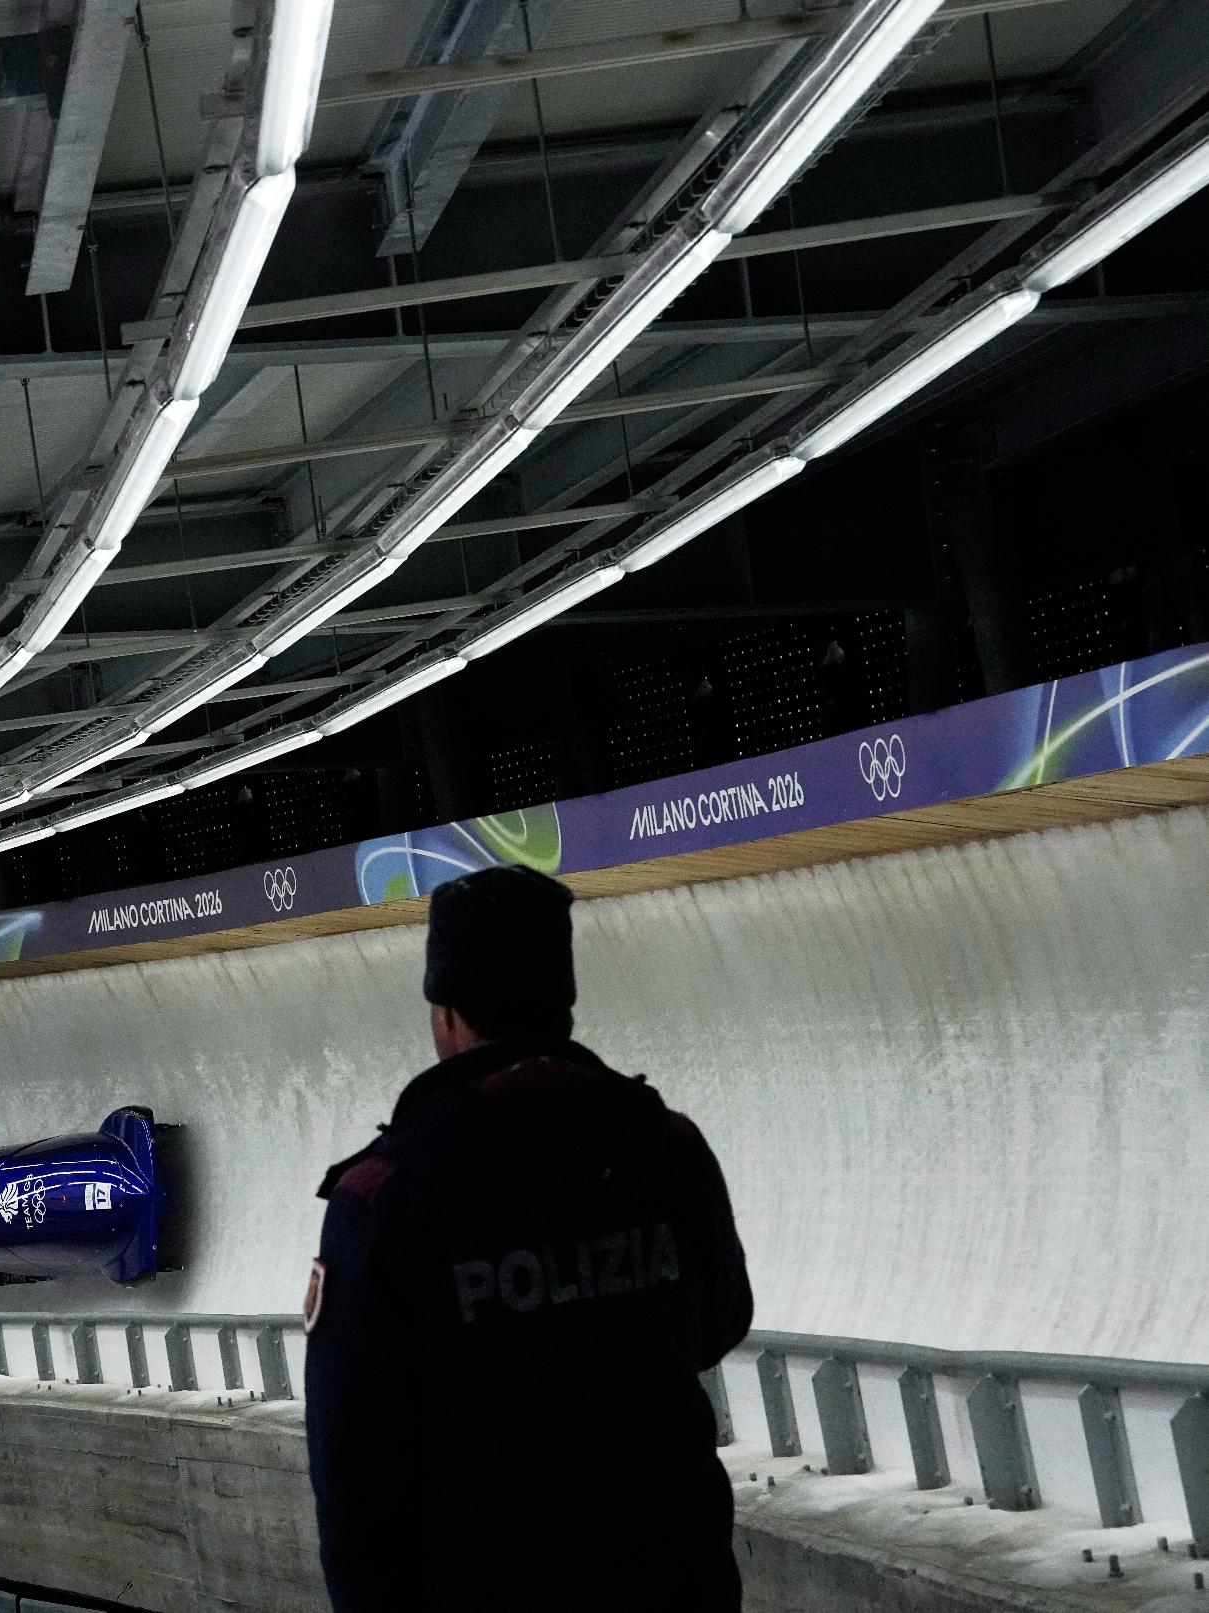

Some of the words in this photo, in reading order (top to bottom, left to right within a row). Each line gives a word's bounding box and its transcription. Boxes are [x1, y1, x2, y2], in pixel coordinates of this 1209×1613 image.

[629, 797, 697, 840] MILANO
[698, 782, 770, 826] CORTINA
[768, 771, 805, 811] 2026
[88, 905, 139, 933] MILANO
[140, 897, 195, 927] CORTINA
[195, 889, 223, 918] 2026
[22, 1195, 34, 1230] TEAM
[96, 1188, 107, 1205] 17
[453, 1223, 680, 1322] POLIZIA
